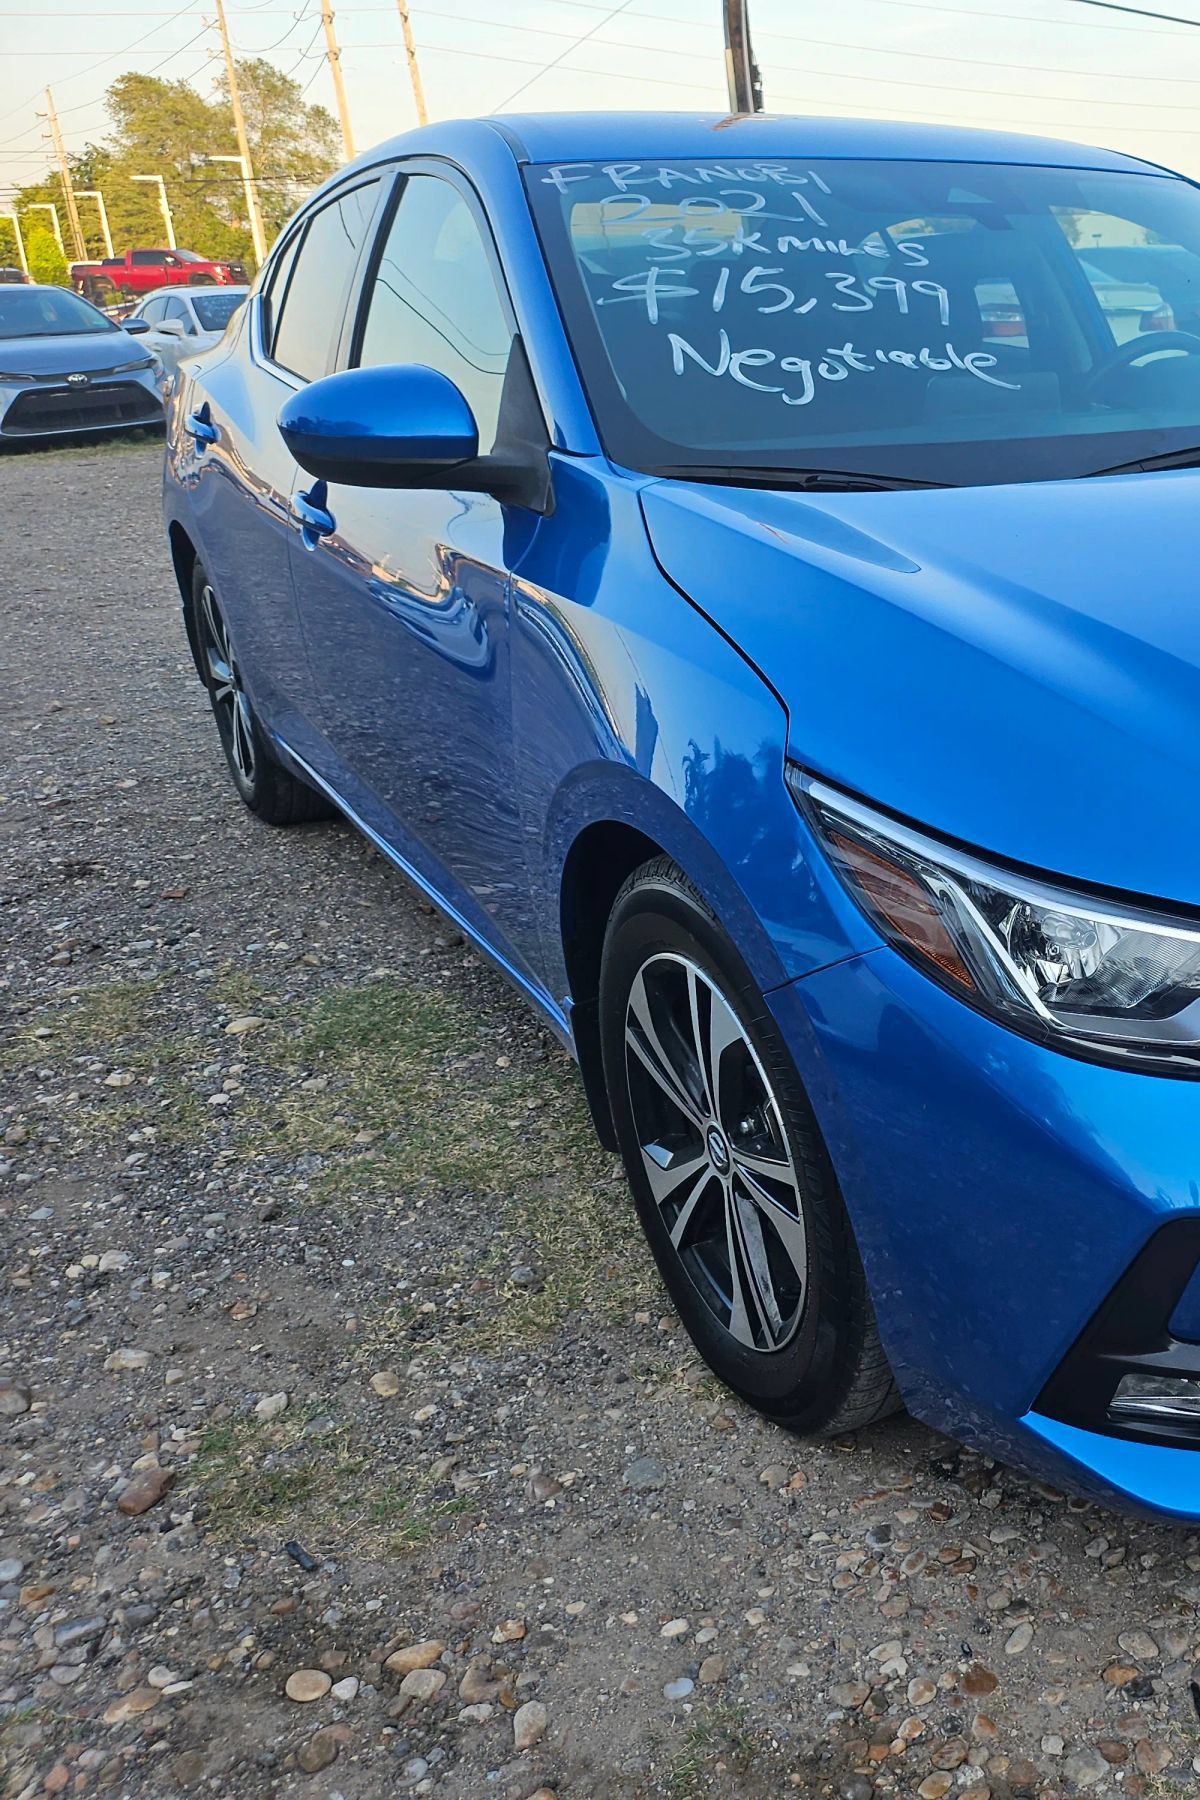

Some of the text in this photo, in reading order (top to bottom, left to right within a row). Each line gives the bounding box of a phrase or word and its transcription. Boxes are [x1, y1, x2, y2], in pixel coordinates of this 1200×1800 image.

[600, 189, 829, 227] 2021
[597, 266, 949, 325] $15,399
[667, 329, 1022, 405] Negotiable
